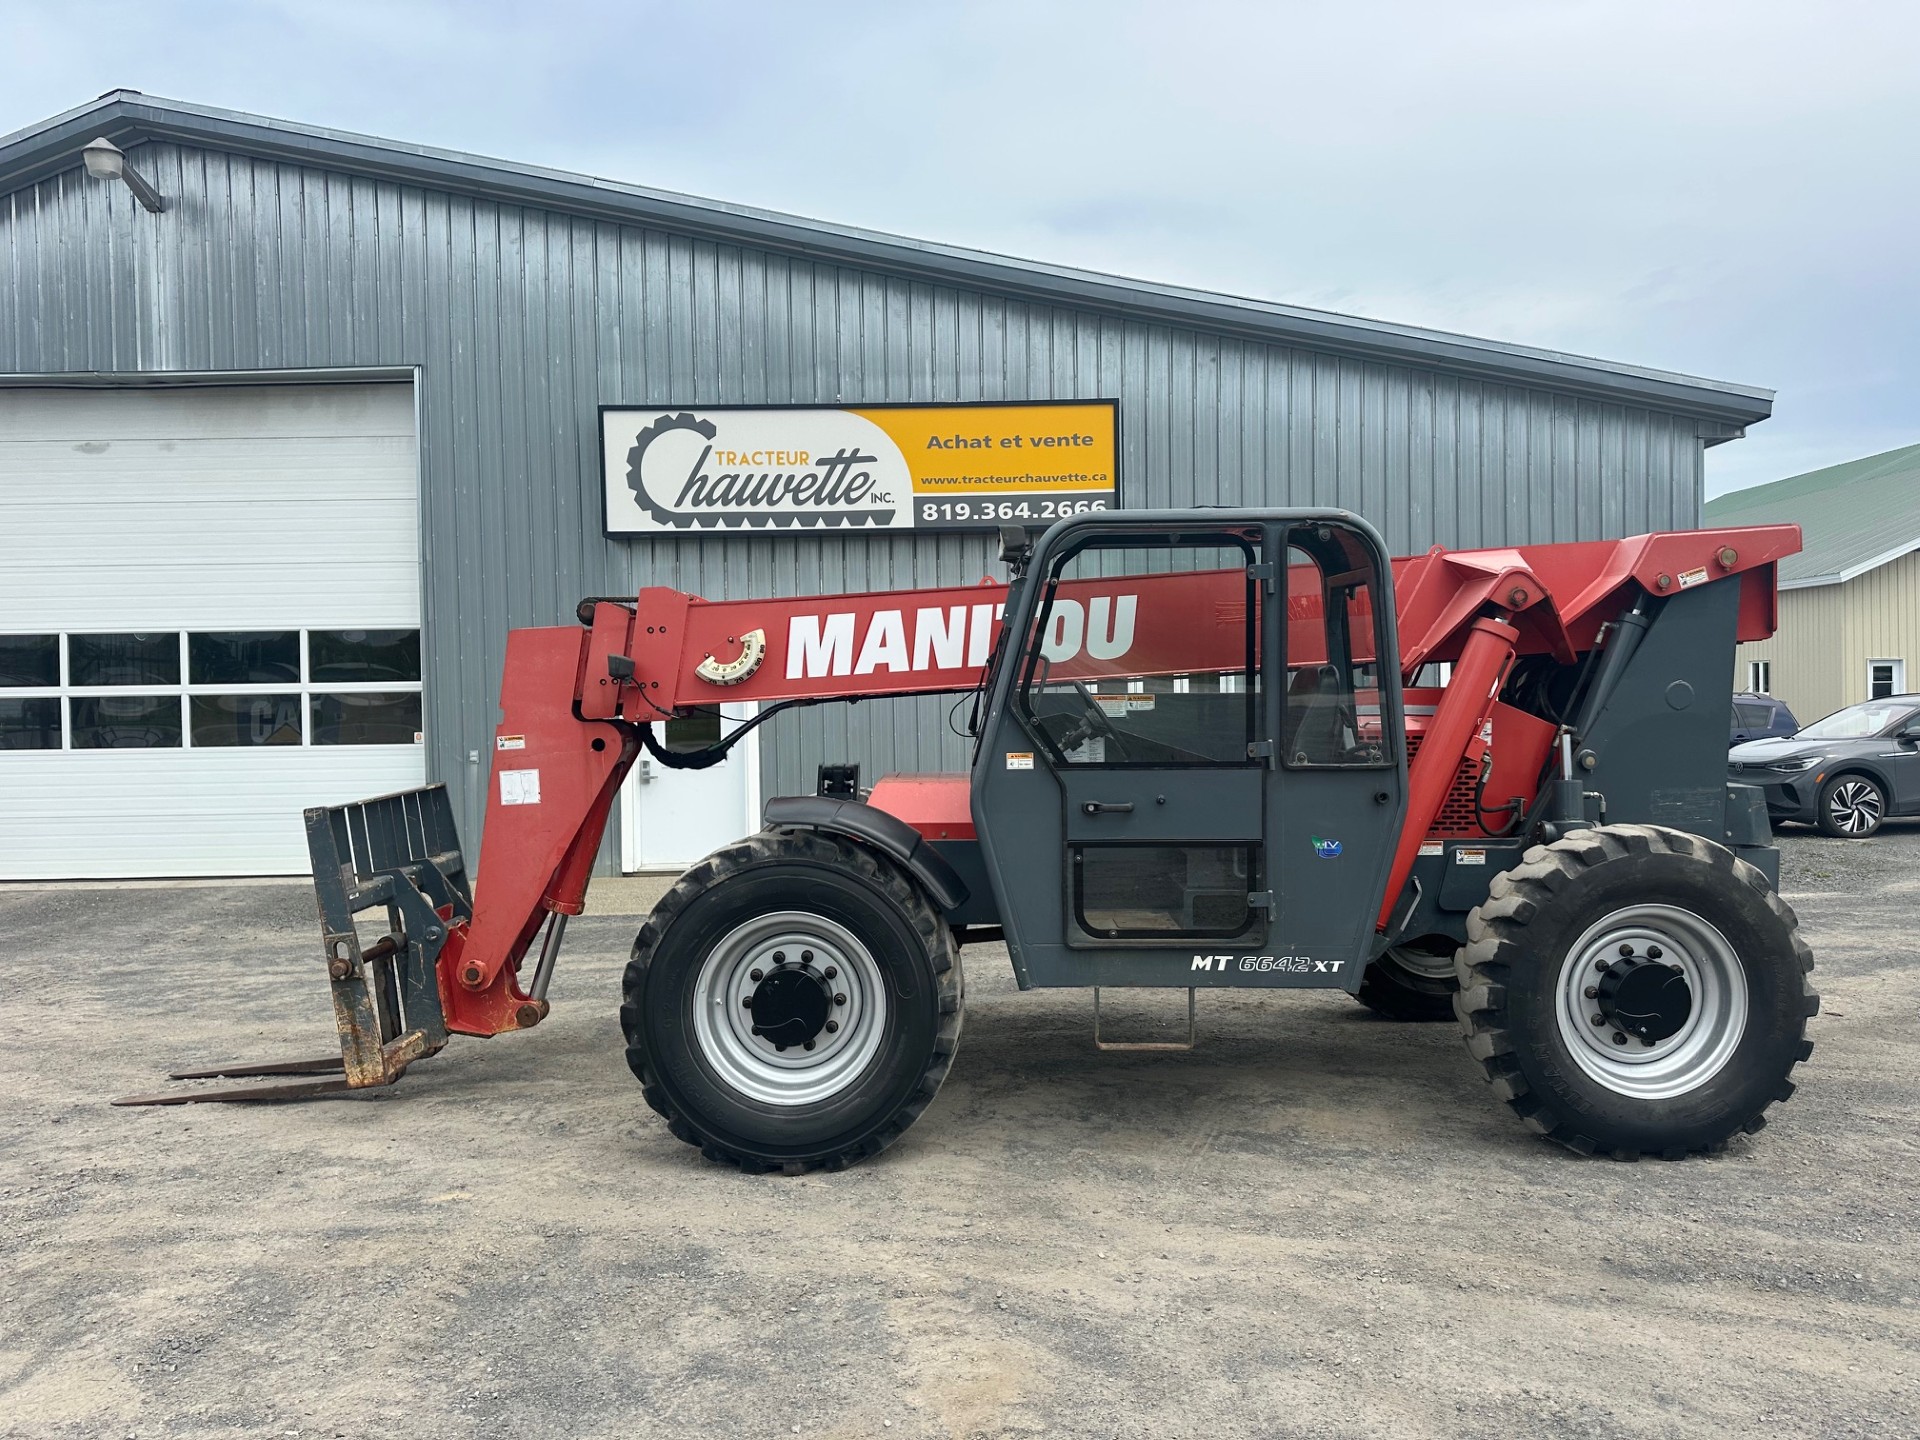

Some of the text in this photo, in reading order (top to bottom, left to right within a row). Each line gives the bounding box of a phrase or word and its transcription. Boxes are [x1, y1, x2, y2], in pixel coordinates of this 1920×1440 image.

[927, 433, 1094, 449] Achat et vente
[715, 450, 810, 466] TRACTEUR
[920, 472, 1108, 485] www.tracteurchauvette.ca
[870, 491, 895, 504] INC.
[922, 499, 1107, 521] 819.364.2666
[1190, 955, 1345, 973] MT 6642 XT
